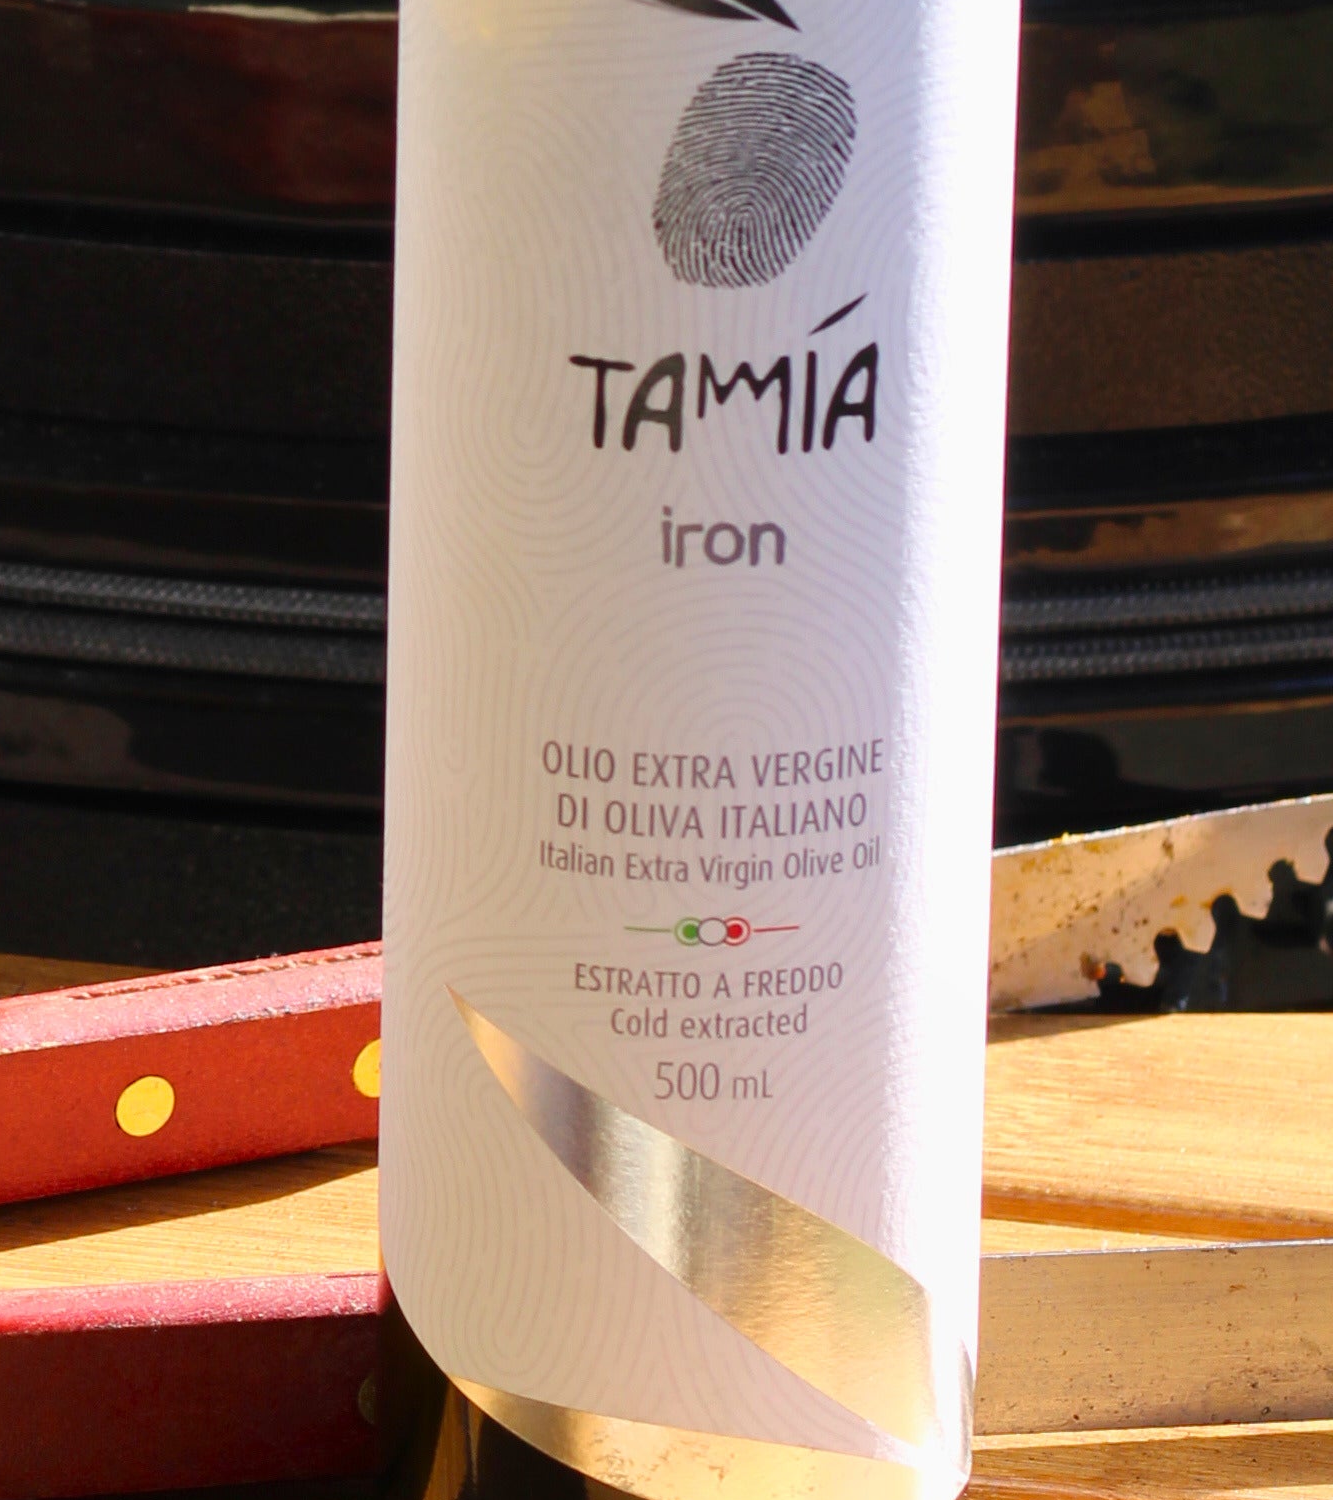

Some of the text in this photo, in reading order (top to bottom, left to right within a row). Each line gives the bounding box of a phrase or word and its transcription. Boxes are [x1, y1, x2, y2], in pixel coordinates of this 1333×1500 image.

[568, 291, 879, 455] TAMÍA
[661, 504, 787, 568] iron
[541, 737, 885, 790] OLIO EXTRA VERGINE
[557, 791, 868, 840] DI OLIVA ITALIANO
[539, 835, 881, 891] Italian Extra Virgin Olive Oil
[574, 961, 844, 1000] ESTRATTO A FREDDO
[610, 1002, 808, 1041] Cold extracted
[653, 1061, 774, 1102] 500 mL
